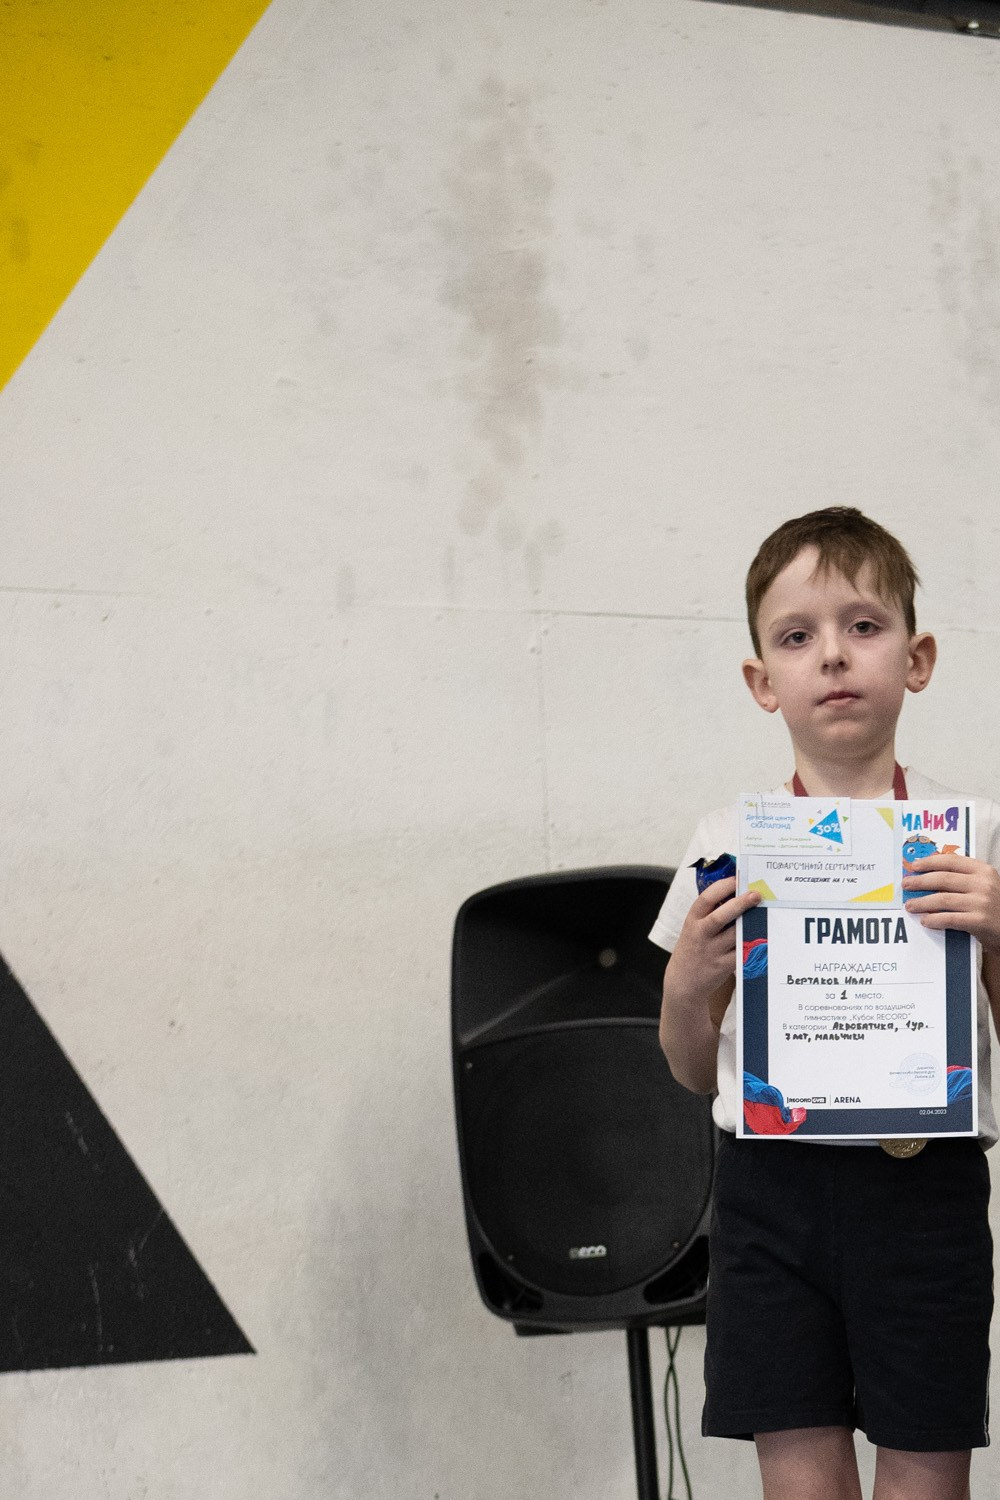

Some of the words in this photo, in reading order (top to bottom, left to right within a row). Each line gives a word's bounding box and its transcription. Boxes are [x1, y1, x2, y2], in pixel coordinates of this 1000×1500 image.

[816, 822, 841, 835] 30%
[804, 917, 908, 944] ГРАМОТА
[814, 962, 898, 972] НАГРАЖДАЕТСЯ
[840, 990, 848, 1000] 1
[804, 1004, 862, 1012] соревнованиях
[875, 1003, 915, 1011] воздушной
